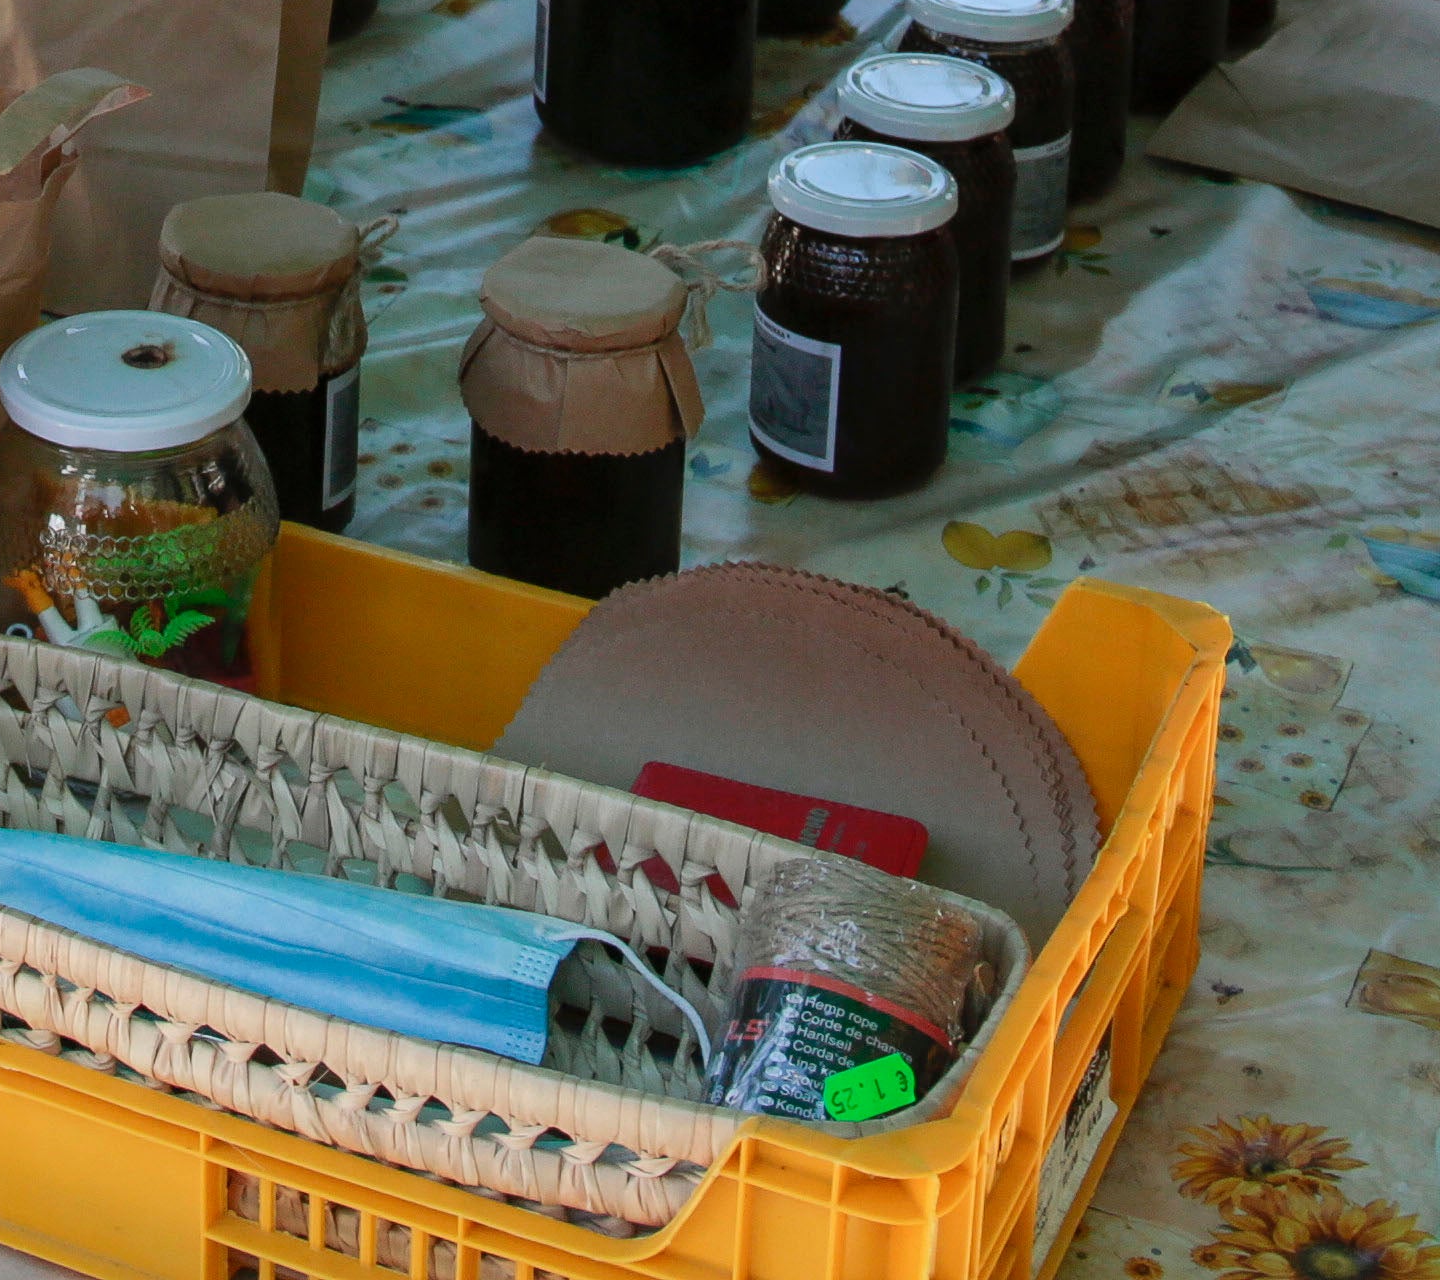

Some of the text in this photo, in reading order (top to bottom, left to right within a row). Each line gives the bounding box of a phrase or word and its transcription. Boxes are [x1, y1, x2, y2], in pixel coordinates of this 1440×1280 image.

[800, 1010, 843, 1032] Corde
[845, 1025, 863, 1040] de
[804, 995, 846, 1018] Hemp
[848, 1012, 879, 1032] rope
[792, 1039, 834, 1061] Corda
[796, 1025, 853, 1052] Hanfseil
